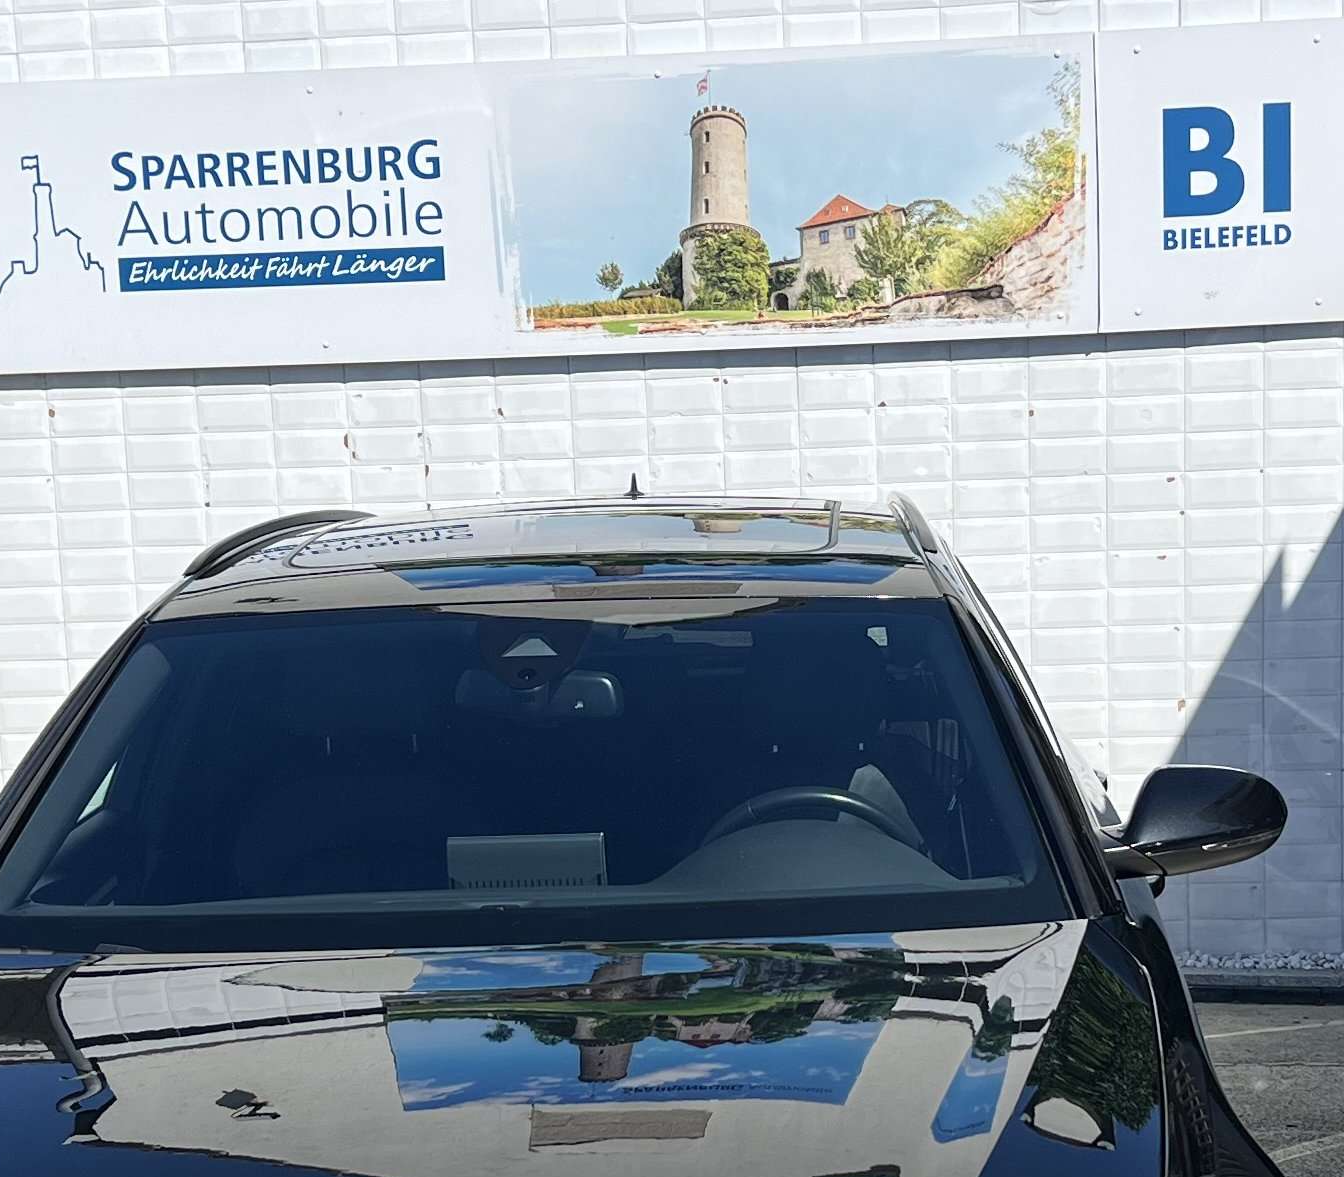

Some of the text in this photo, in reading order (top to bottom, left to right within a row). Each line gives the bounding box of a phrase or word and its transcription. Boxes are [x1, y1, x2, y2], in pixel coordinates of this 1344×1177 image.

[111, 139, 442, 192] SPARRENBURG
[1162, 102, 1292, 218] BI
[117, 187, 444, 247] Automobile
[1163, 224, 1292, 250] BIELEFELD
[128, 253, 436, 284] Ehrlichkeit Fährt Länger
